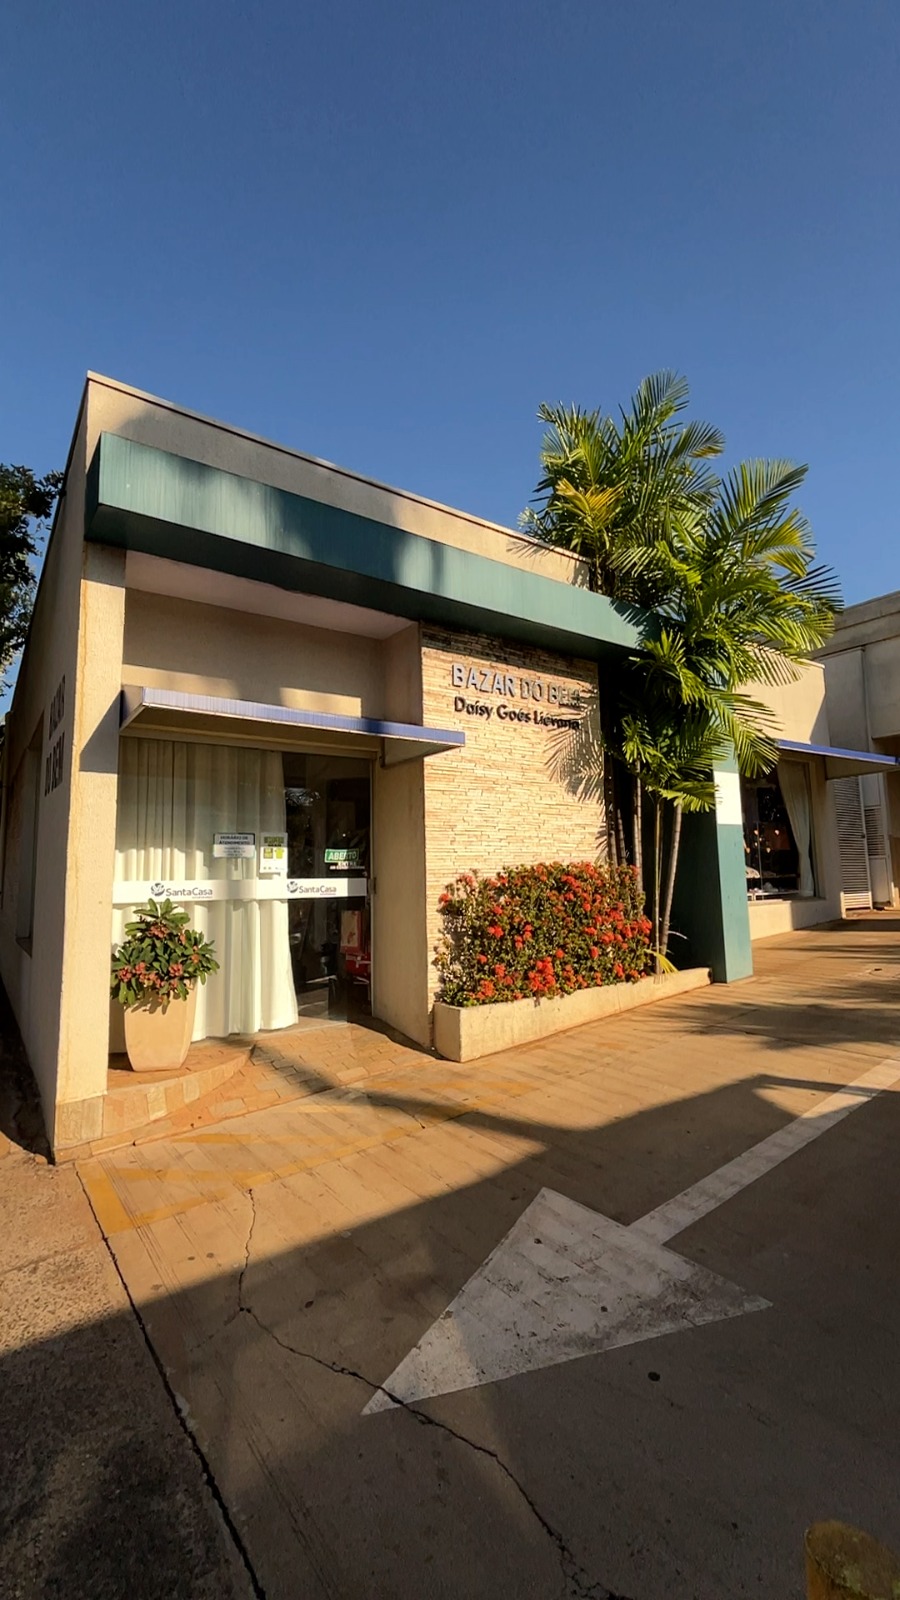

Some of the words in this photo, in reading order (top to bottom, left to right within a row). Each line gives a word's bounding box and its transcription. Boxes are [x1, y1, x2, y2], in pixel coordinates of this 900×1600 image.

[452, 663, 515, 698] BAZAR
[520, 677, 545, 702] DO
[454, 696, 493, 721] Daisy
